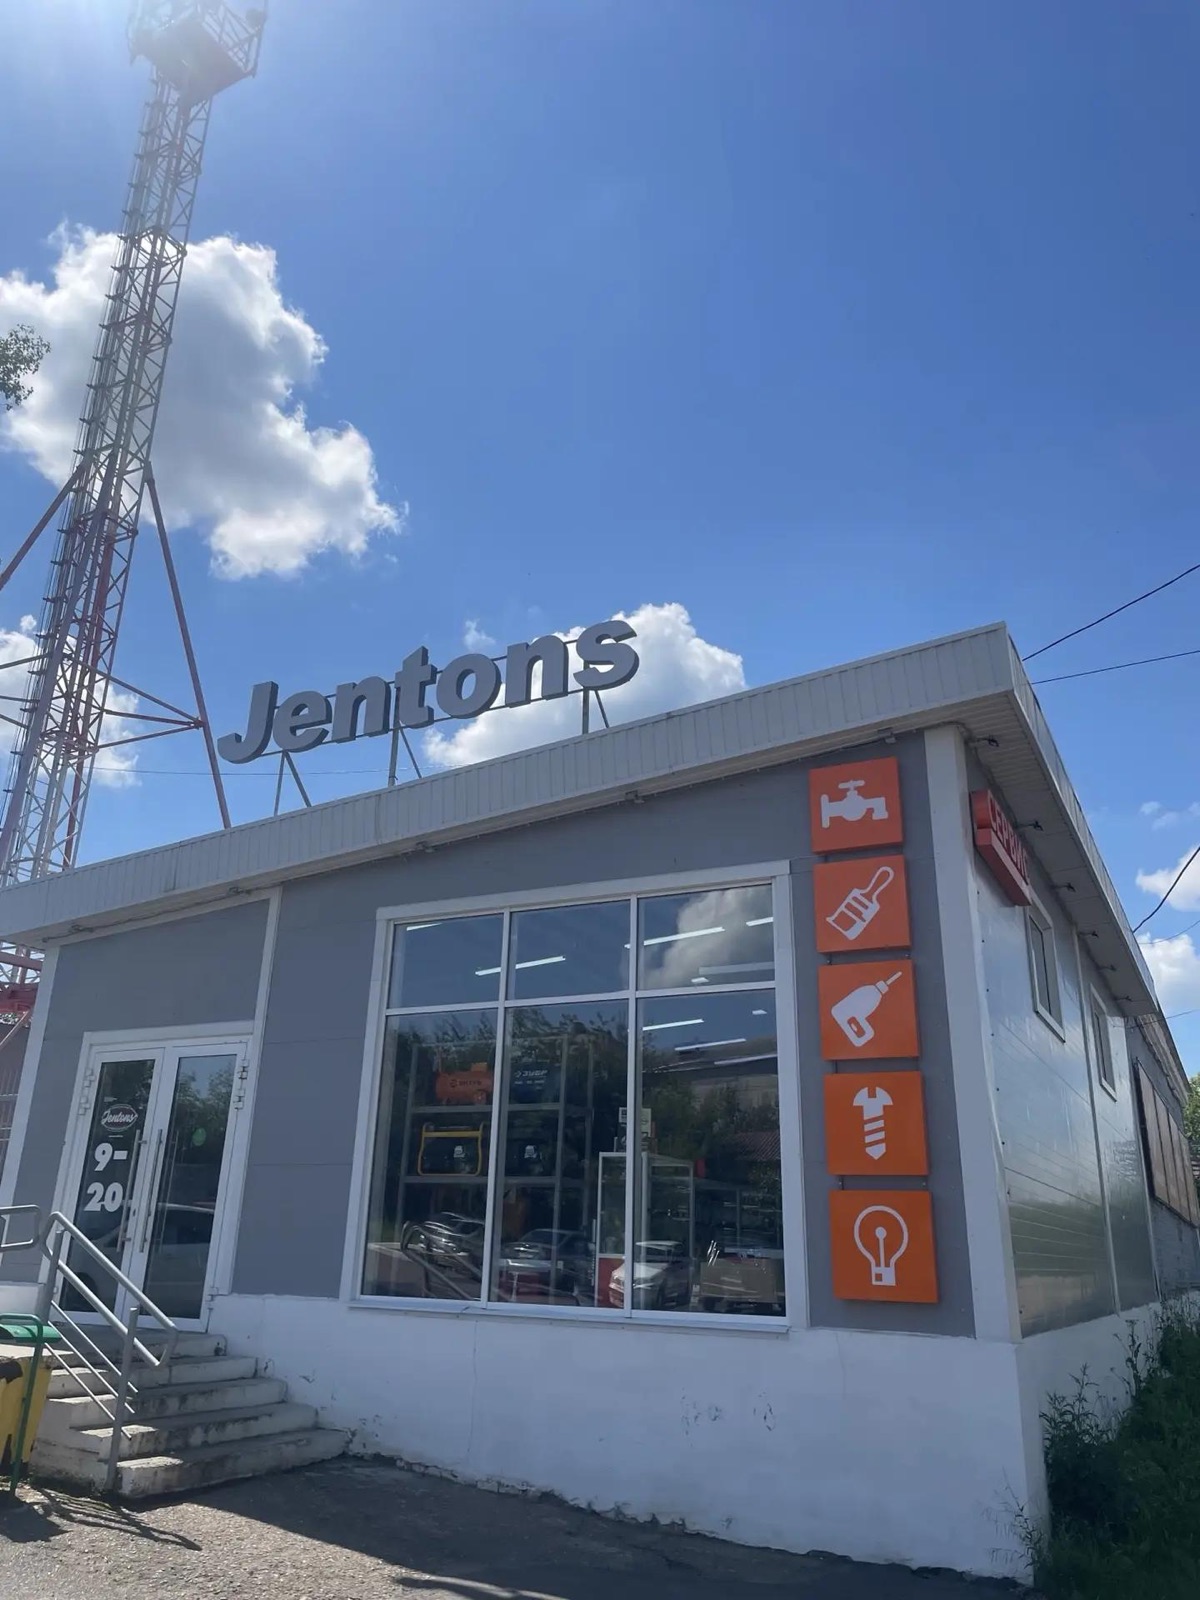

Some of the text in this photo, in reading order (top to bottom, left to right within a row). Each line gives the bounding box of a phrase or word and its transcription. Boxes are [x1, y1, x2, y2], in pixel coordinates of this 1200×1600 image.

[217, 620, 639, 763] Jentons
[101, 1110, 138, 1125] Jentons
[94, 1142, 128, 1171] 9-
[84, 1182, 123, 1212] 20
